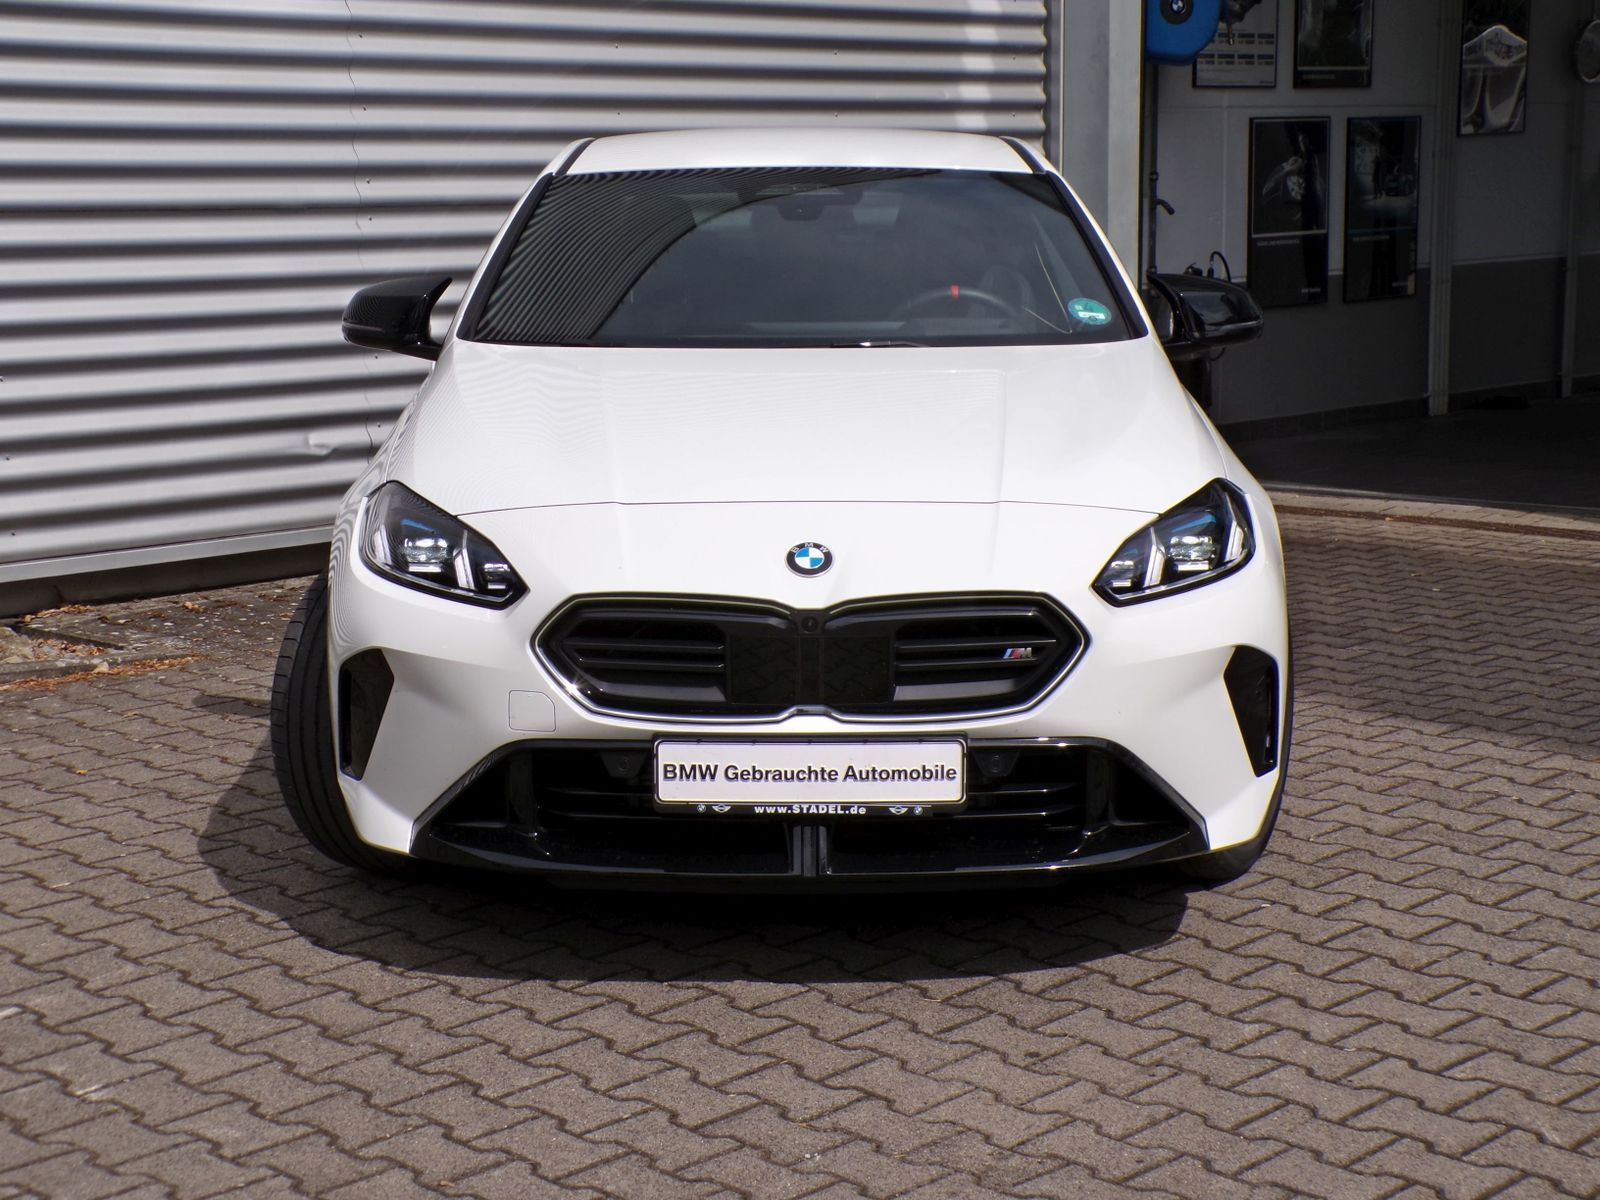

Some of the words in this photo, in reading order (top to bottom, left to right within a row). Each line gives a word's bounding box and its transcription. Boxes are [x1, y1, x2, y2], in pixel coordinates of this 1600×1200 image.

[790, 542, 829, 553] BMW
[662, 763, 718, 781] BMW
[724, 764, 839, 782] Gebrauchte
[843, 764, 957, 781] Automobile
[754, 804, 867, 815] www.STADEL.de
